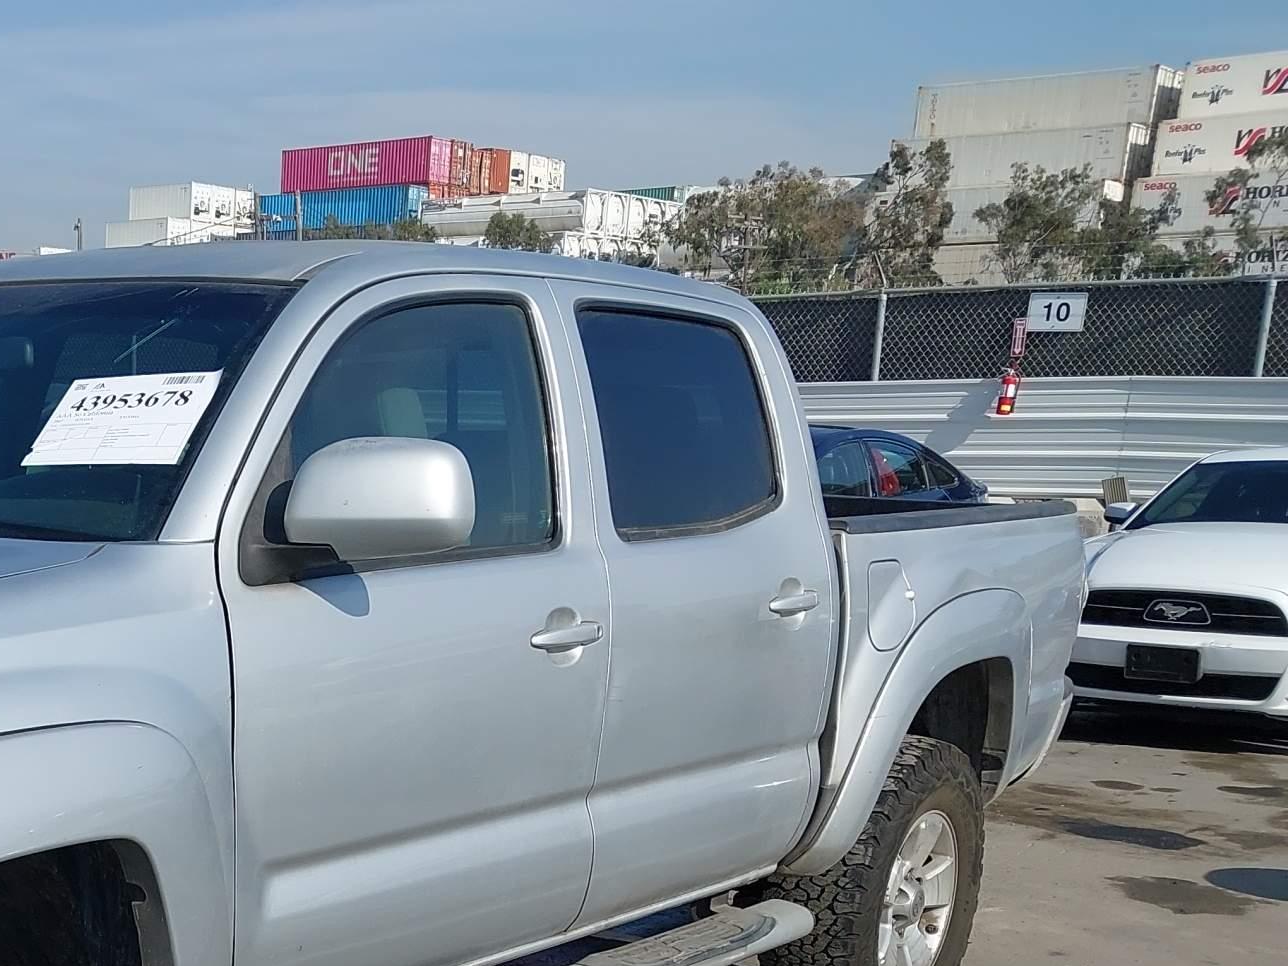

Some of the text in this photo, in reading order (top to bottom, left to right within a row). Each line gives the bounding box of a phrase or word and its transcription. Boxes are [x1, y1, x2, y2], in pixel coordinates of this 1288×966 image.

[1196, 63, 1230, 74] seaco
[1168, 122, 1202, 133] seaco
[328, 148, 378, 176] ONE
[1143, 182, 1176, 191] seaco
[1043, 302, 1071, 322] 10
[71, 390, 192, 411] 43953678
